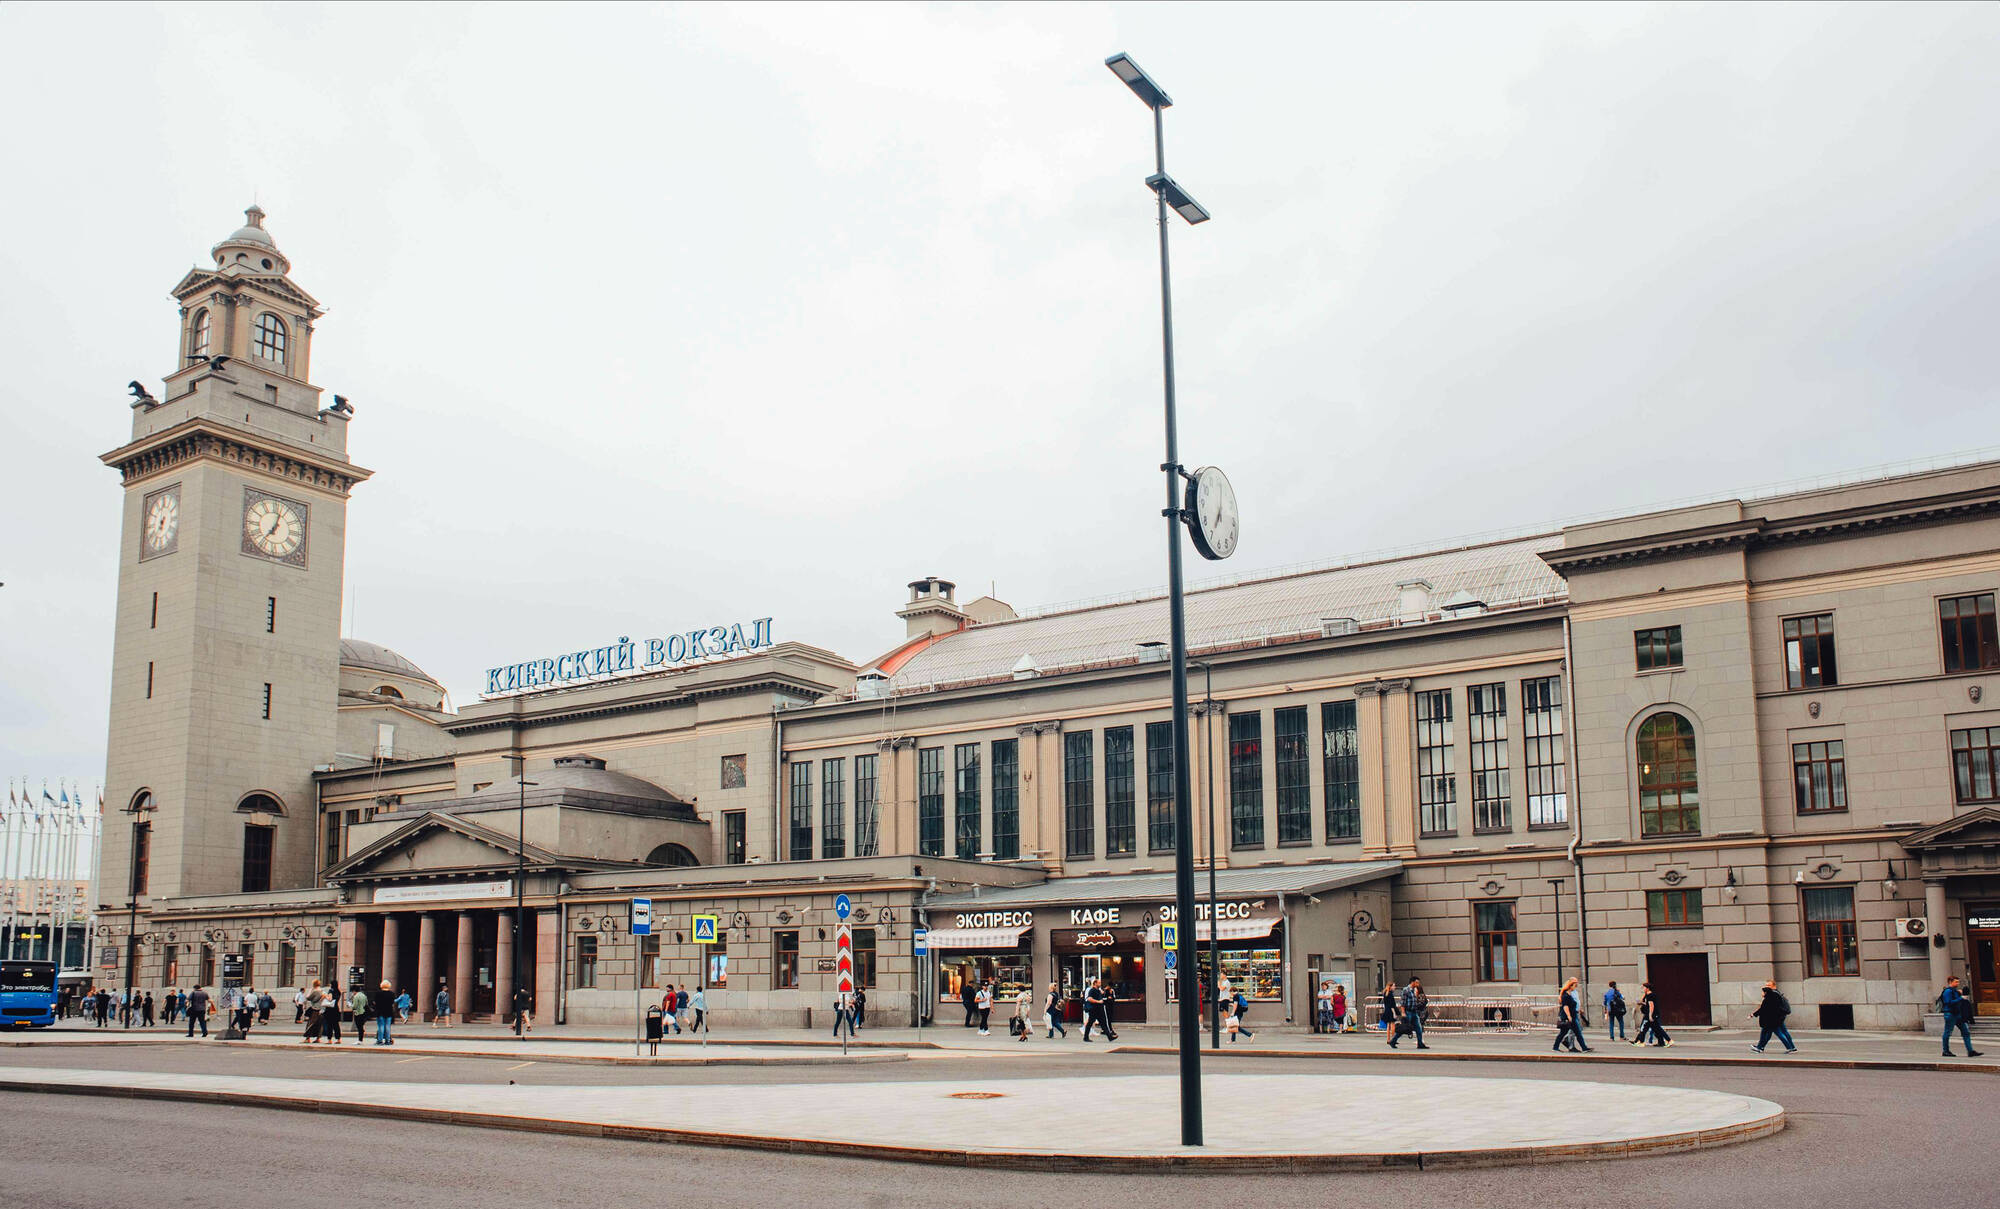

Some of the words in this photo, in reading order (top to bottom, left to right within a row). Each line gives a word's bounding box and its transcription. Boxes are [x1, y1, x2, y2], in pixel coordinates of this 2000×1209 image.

[1203, 515, 1207, 526] 8
[1210, 530, 1214, 540] 7
[1217, 539, 1221, 549] 6
[1225, 538, 1229, 549] 5
[485, 636, 635, 694] КИЕВСКИЙ
[644, 617, 773, 667] ВОКЗАЛ
[1071, 908, 1120, 925] КАФЕ
[1160, 902, 1251, 921] ЭКПРЕСС
[955, 911, 1033, 929] ЭКСПРЕСС
